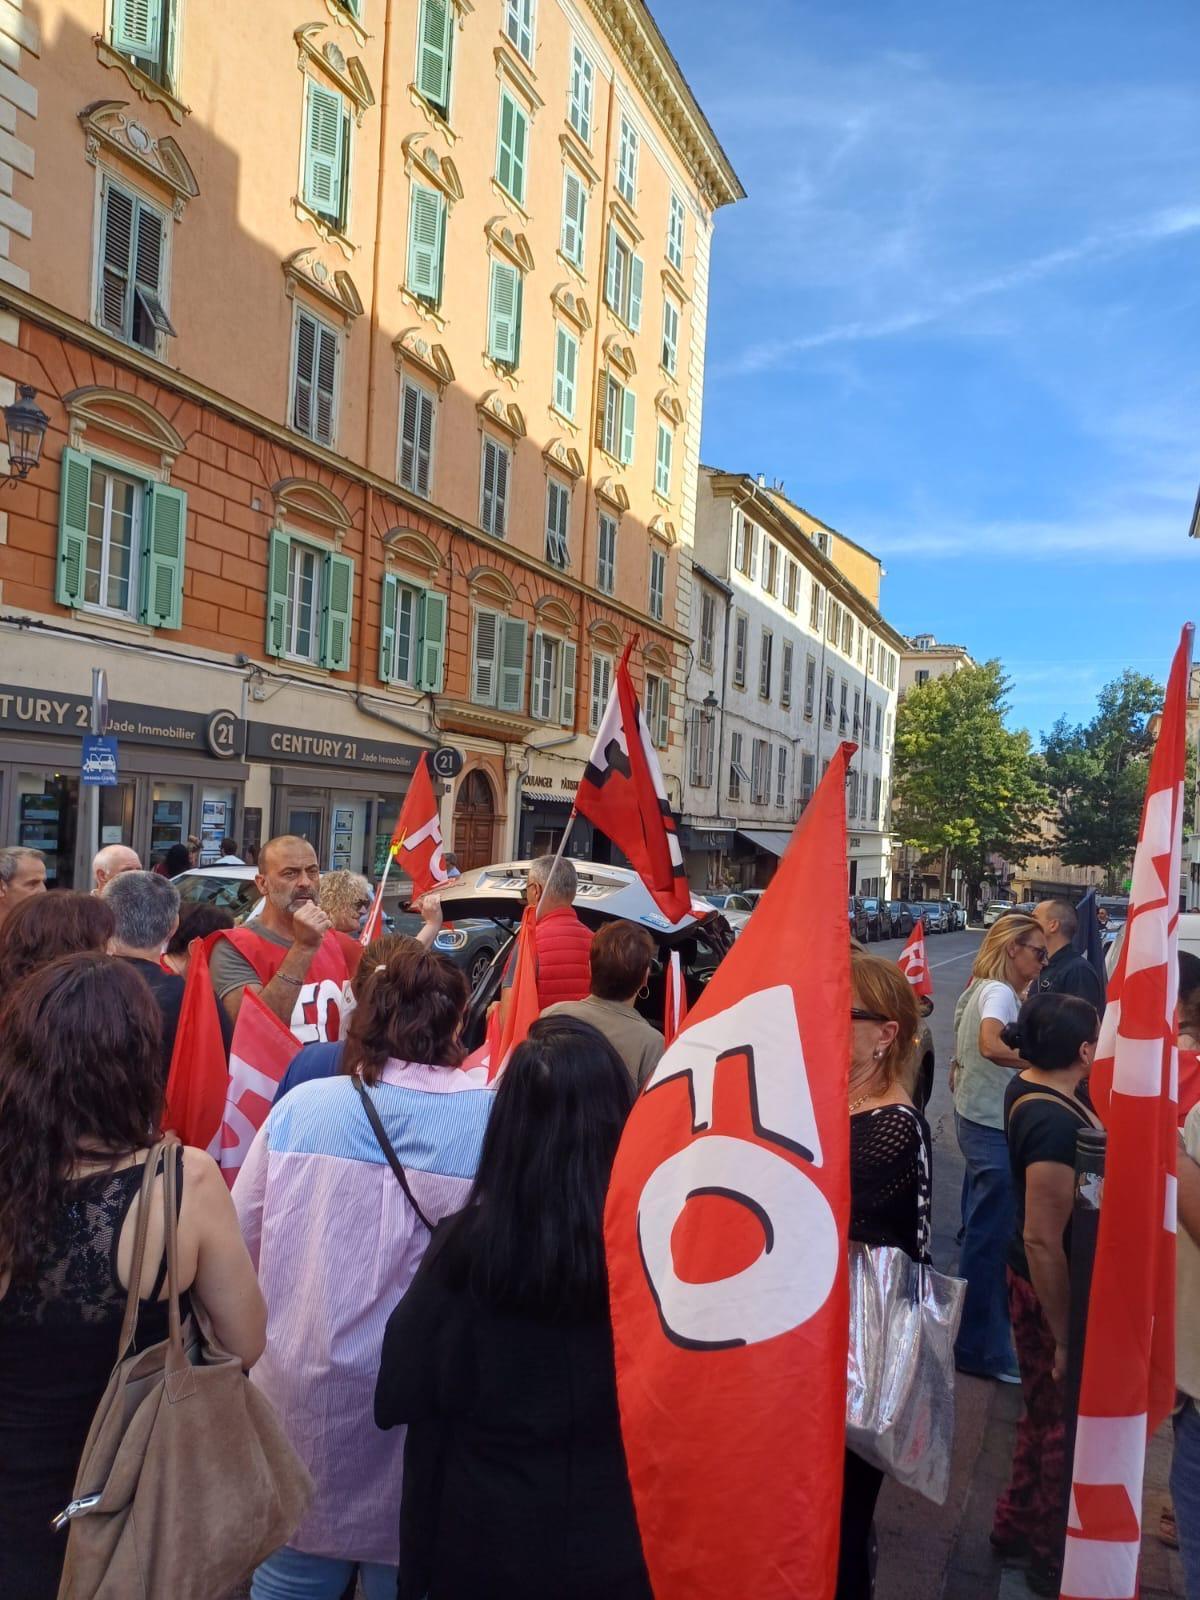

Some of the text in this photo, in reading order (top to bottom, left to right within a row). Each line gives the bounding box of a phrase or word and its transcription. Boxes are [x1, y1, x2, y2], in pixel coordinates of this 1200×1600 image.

[106, 719, 135, 733] Jade
[138, 723, 196, 740] Immobilier
[271, 733, 411, 766] CENTURY 21 Jade Immobilier
[636, 984, 840, 1353] FO
